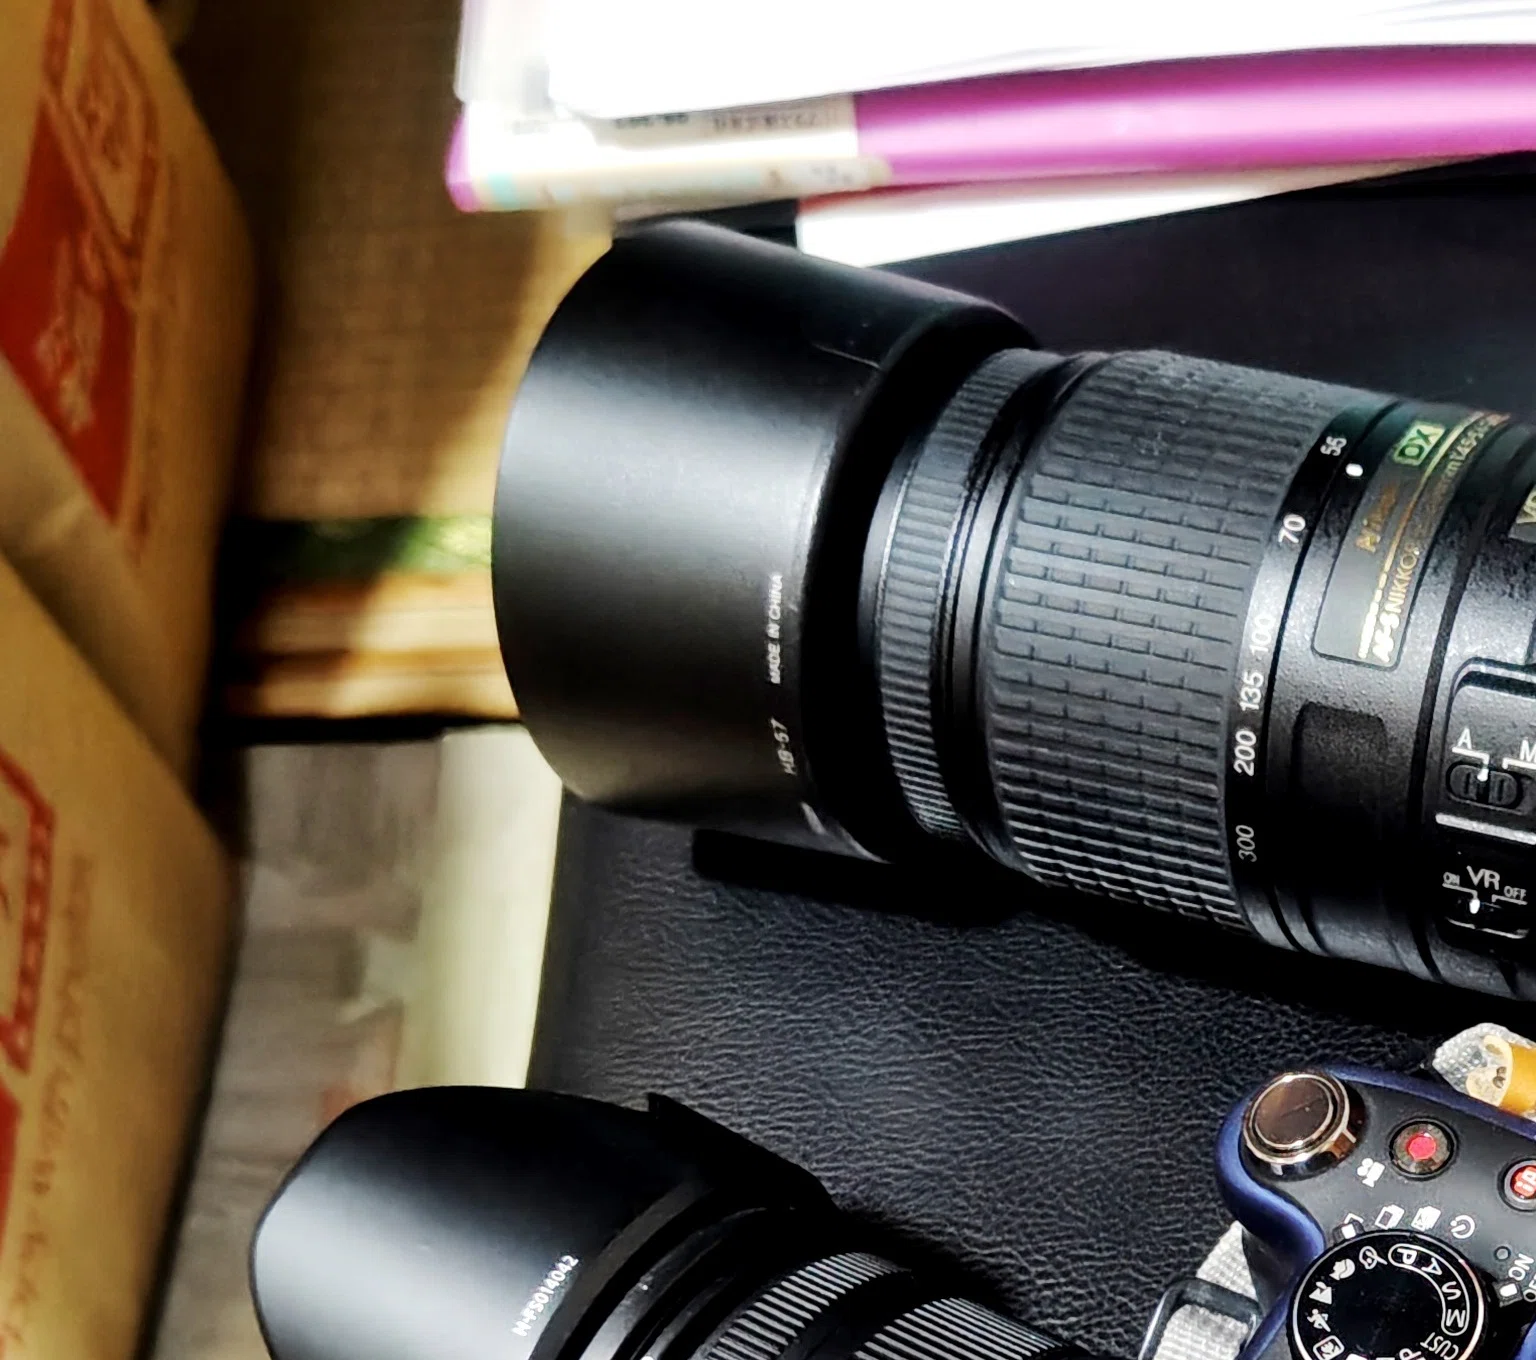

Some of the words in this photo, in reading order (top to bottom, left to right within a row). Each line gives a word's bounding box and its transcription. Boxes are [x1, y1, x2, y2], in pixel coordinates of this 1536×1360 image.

[1320, 435, 1347, 456] 55
[1395, 424, 1444, 462] DX
[1278, 513, 1306, 544] 70
[767, 574, 783, 621] CHINA
[766, 622, 780, 639] IN
[1249, 614, 1277, 656] 100
[766, 642, 781, 684] MADE
[1239, 671, 1264, 711] 135
[1457, 727, 1472, 749] A
[1233, 729, 1258, 776] 200
[1235, 824, 1258, 862] 300
[1442, 871, 1461, 885] ON
[1466, 865, 1501, 890] VR
[1503, 885, 1528, 900] OFF
[1397, 1248, 1418, 1264] P
[1421, 1258, 1442, 1275] A
[1508, 1252, 1535, 1282] ON
[511, 1254, 579, 1337] H-FS014042
[1441, 1281, 1462, 1300] S
[1446, 1309, 1466, 1328] M
[1420, 1332, 1460, 1360] CUST
